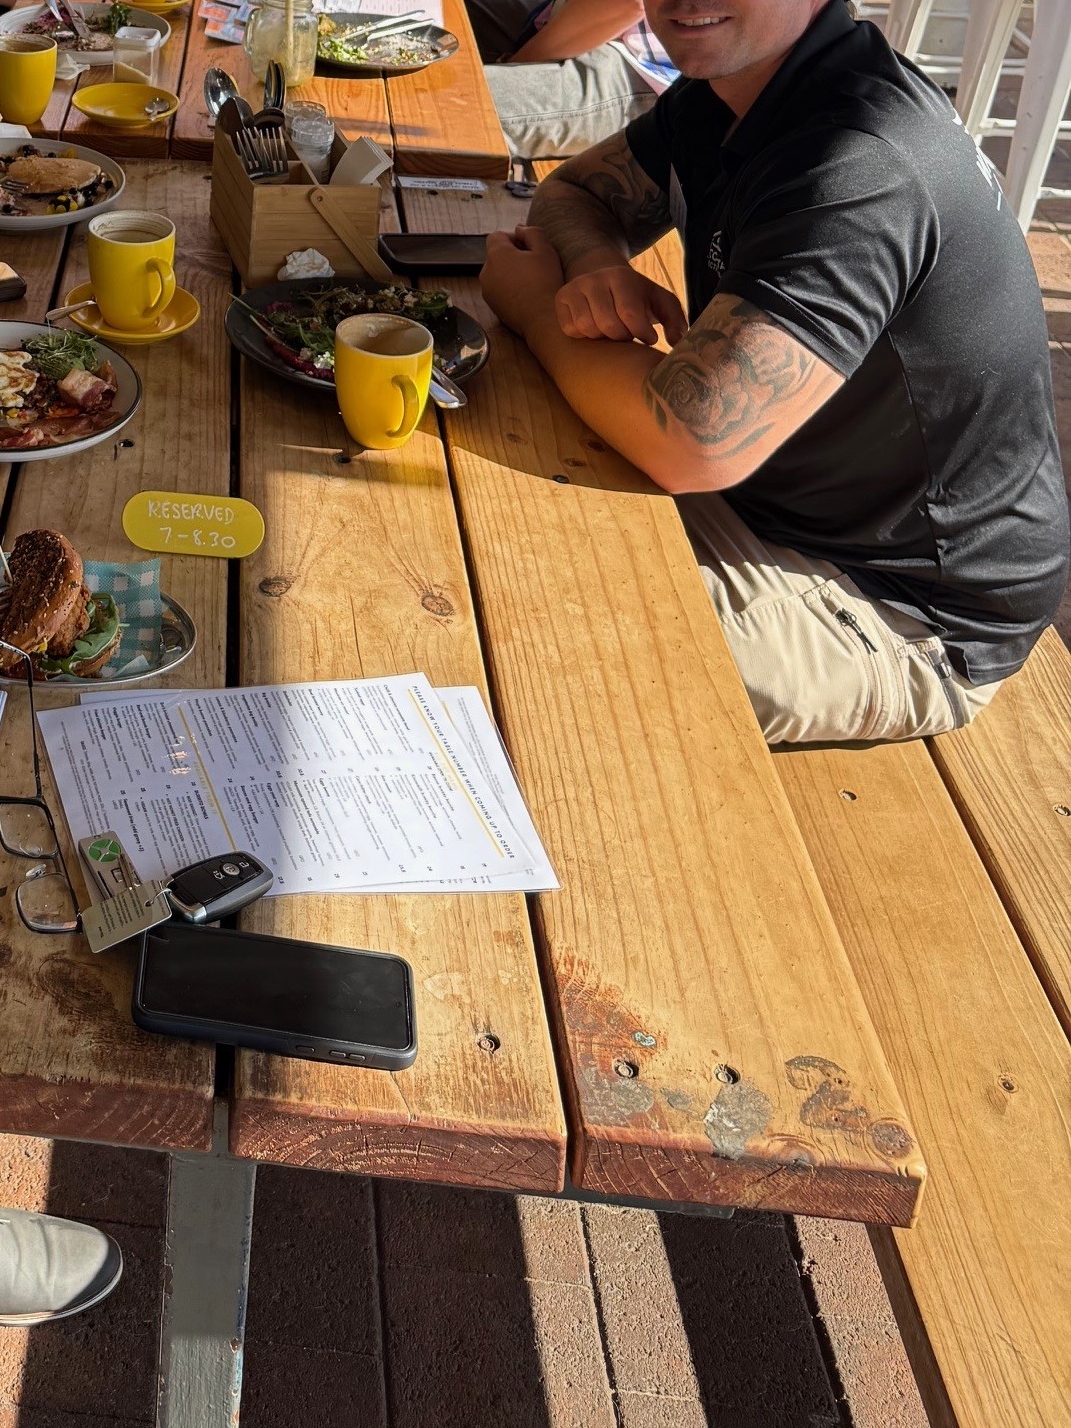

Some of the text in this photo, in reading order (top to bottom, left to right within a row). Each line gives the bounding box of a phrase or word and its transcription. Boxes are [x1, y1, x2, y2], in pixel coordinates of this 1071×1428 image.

[148, 500, 235, 525] RESERVED
[412, 685, 426, 704] PLEASE
[423, 705, 436, 721] KNOW
[433, 722, 444, 737] YOUR
[441, 737, 454, 754] TABLE
[451, 755, 468, 777] NUMBER
[464, 778, 478, 795] WHEN
[474, 796, 492, 820] COMING
[489, 821, 498, 829] UP
[494, 830, 503, 838] TO
[500, 839, 515, 859] ORDER
